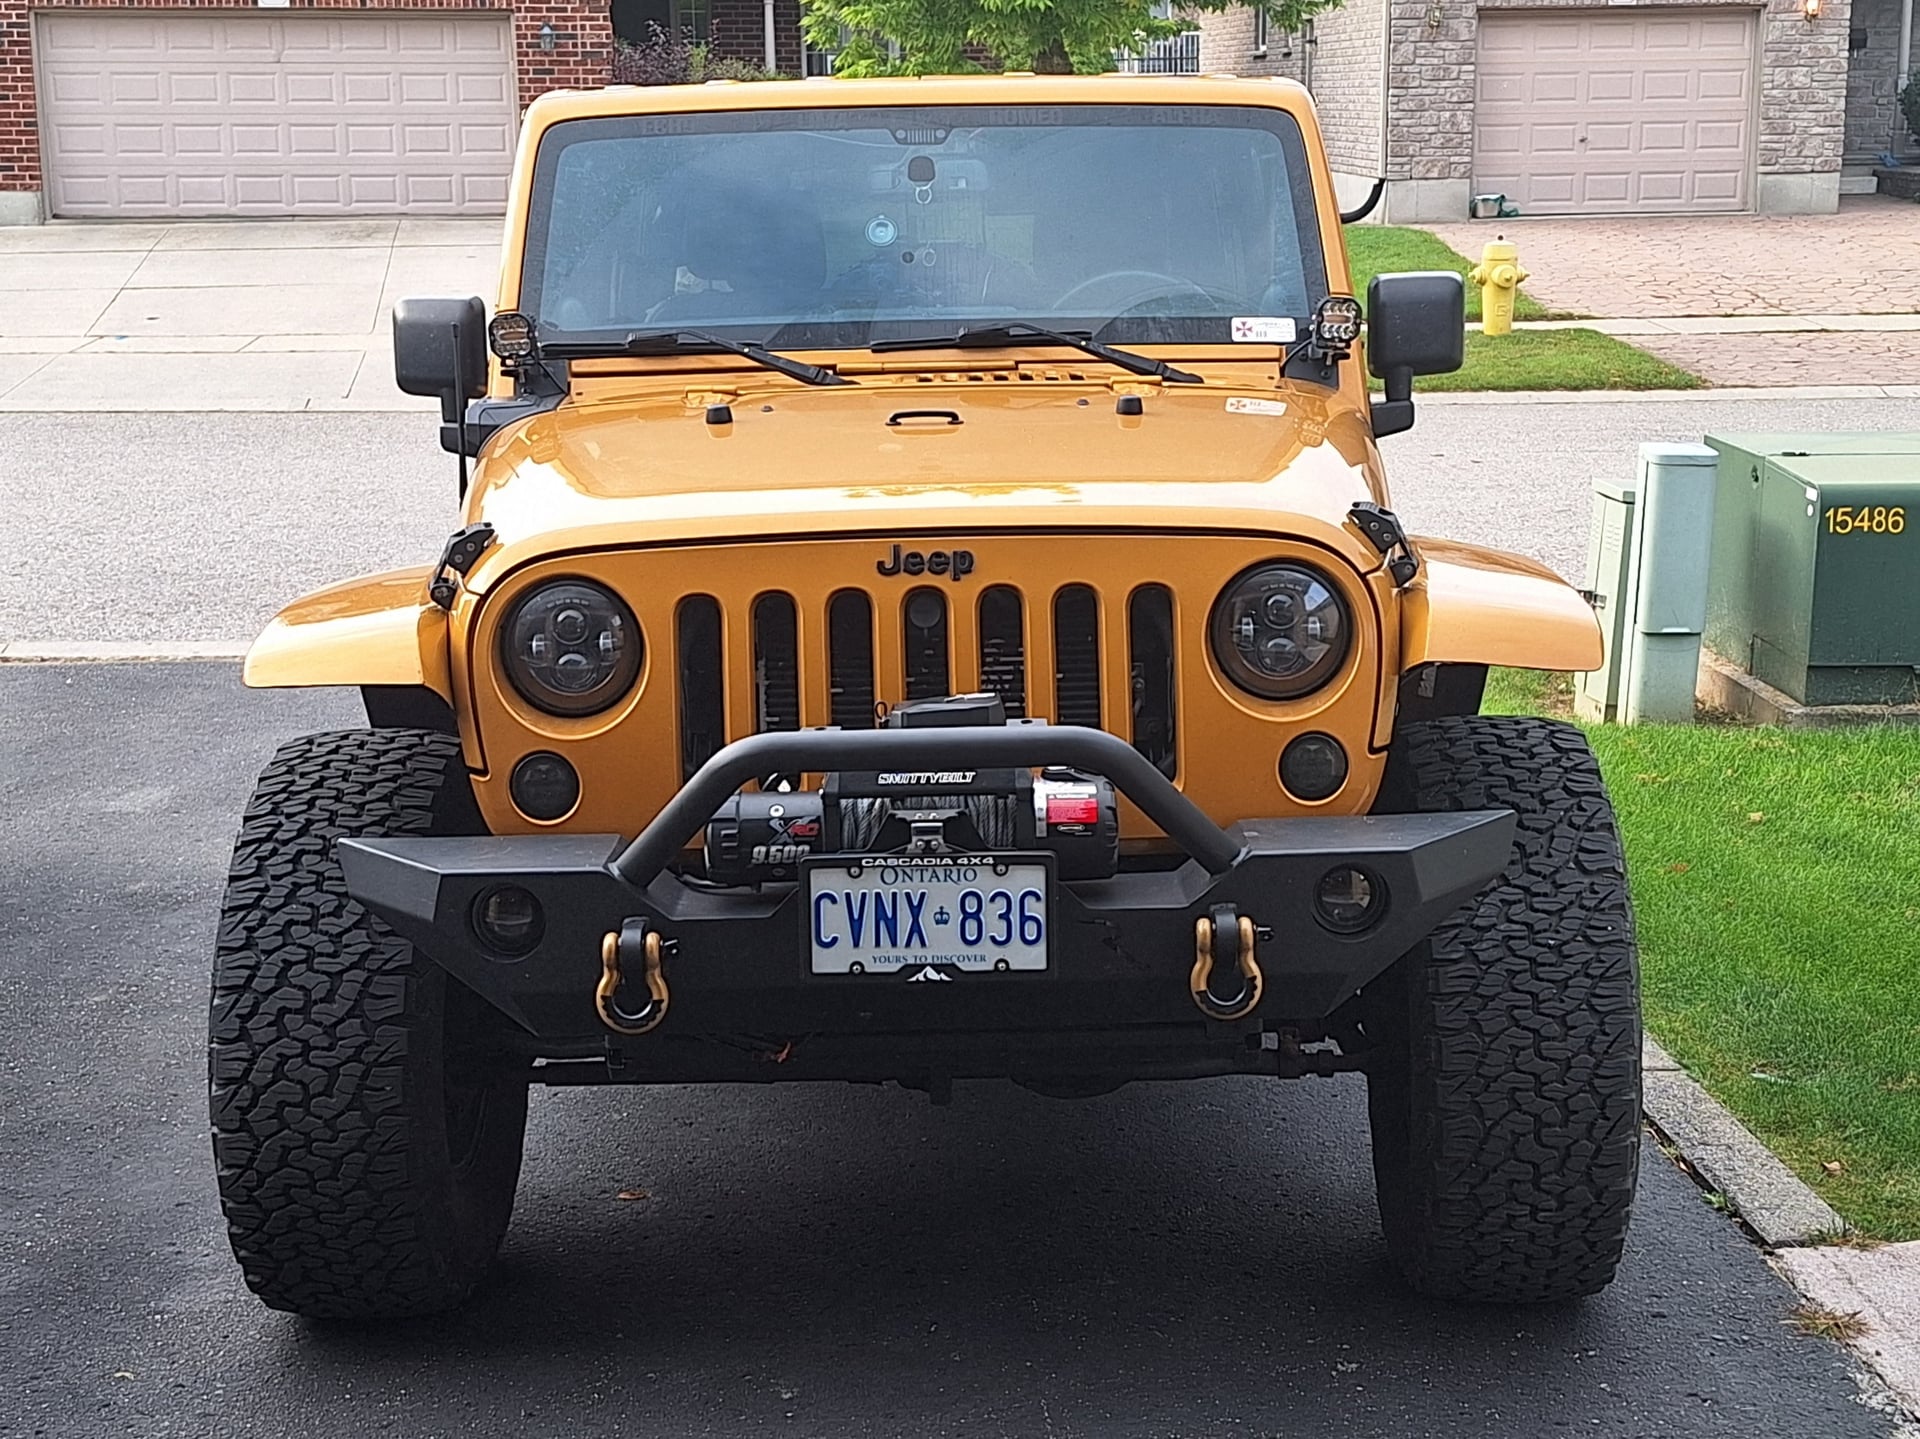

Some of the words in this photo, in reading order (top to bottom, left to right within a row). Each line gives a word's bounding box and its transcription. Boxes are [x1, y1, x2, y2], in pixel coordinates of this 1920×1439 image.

[1825, 506, 1905, 534] 15486
[876, 543, 975, 582] Jeep
[877, 771, 977, 785] SMITTYBILT
[861, 857, 954, 867] CASCADIA
[956, 856, 995, 865] 4X4
[814, 891, 928, 949] CVNX
[959, 889, 1043, 947] 836
[872, 954, 909, 964] YOURS
[912, 954, 928, 964] TO
[931, 953, 987, 964] DISCOVER
